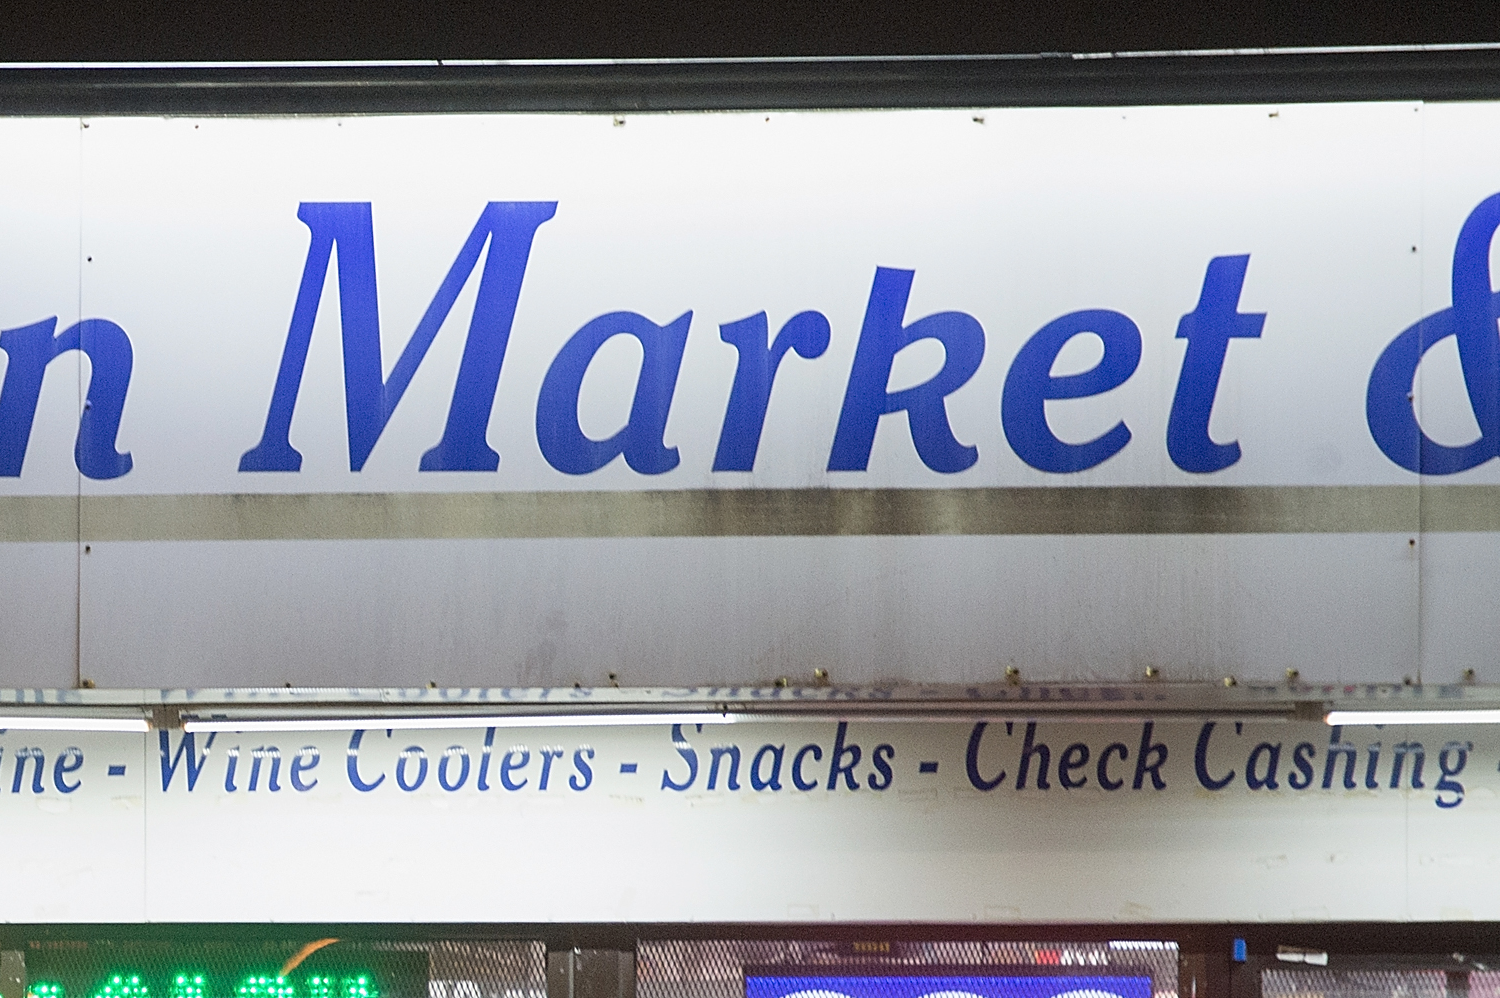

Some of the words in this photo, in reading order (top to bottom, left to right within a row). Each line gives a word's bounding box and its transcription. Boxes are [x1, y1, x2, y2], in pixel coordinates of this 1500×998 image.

[238, 201, 1269, 476] Market
[158, 727, 322, 795] Wine
[346, 725, 597, 795] Coolers
[661, 723, 896, 794] Snacks
[964, 722, 1169, 792] Check
[1193, 722, 1475, 810] Cashing
